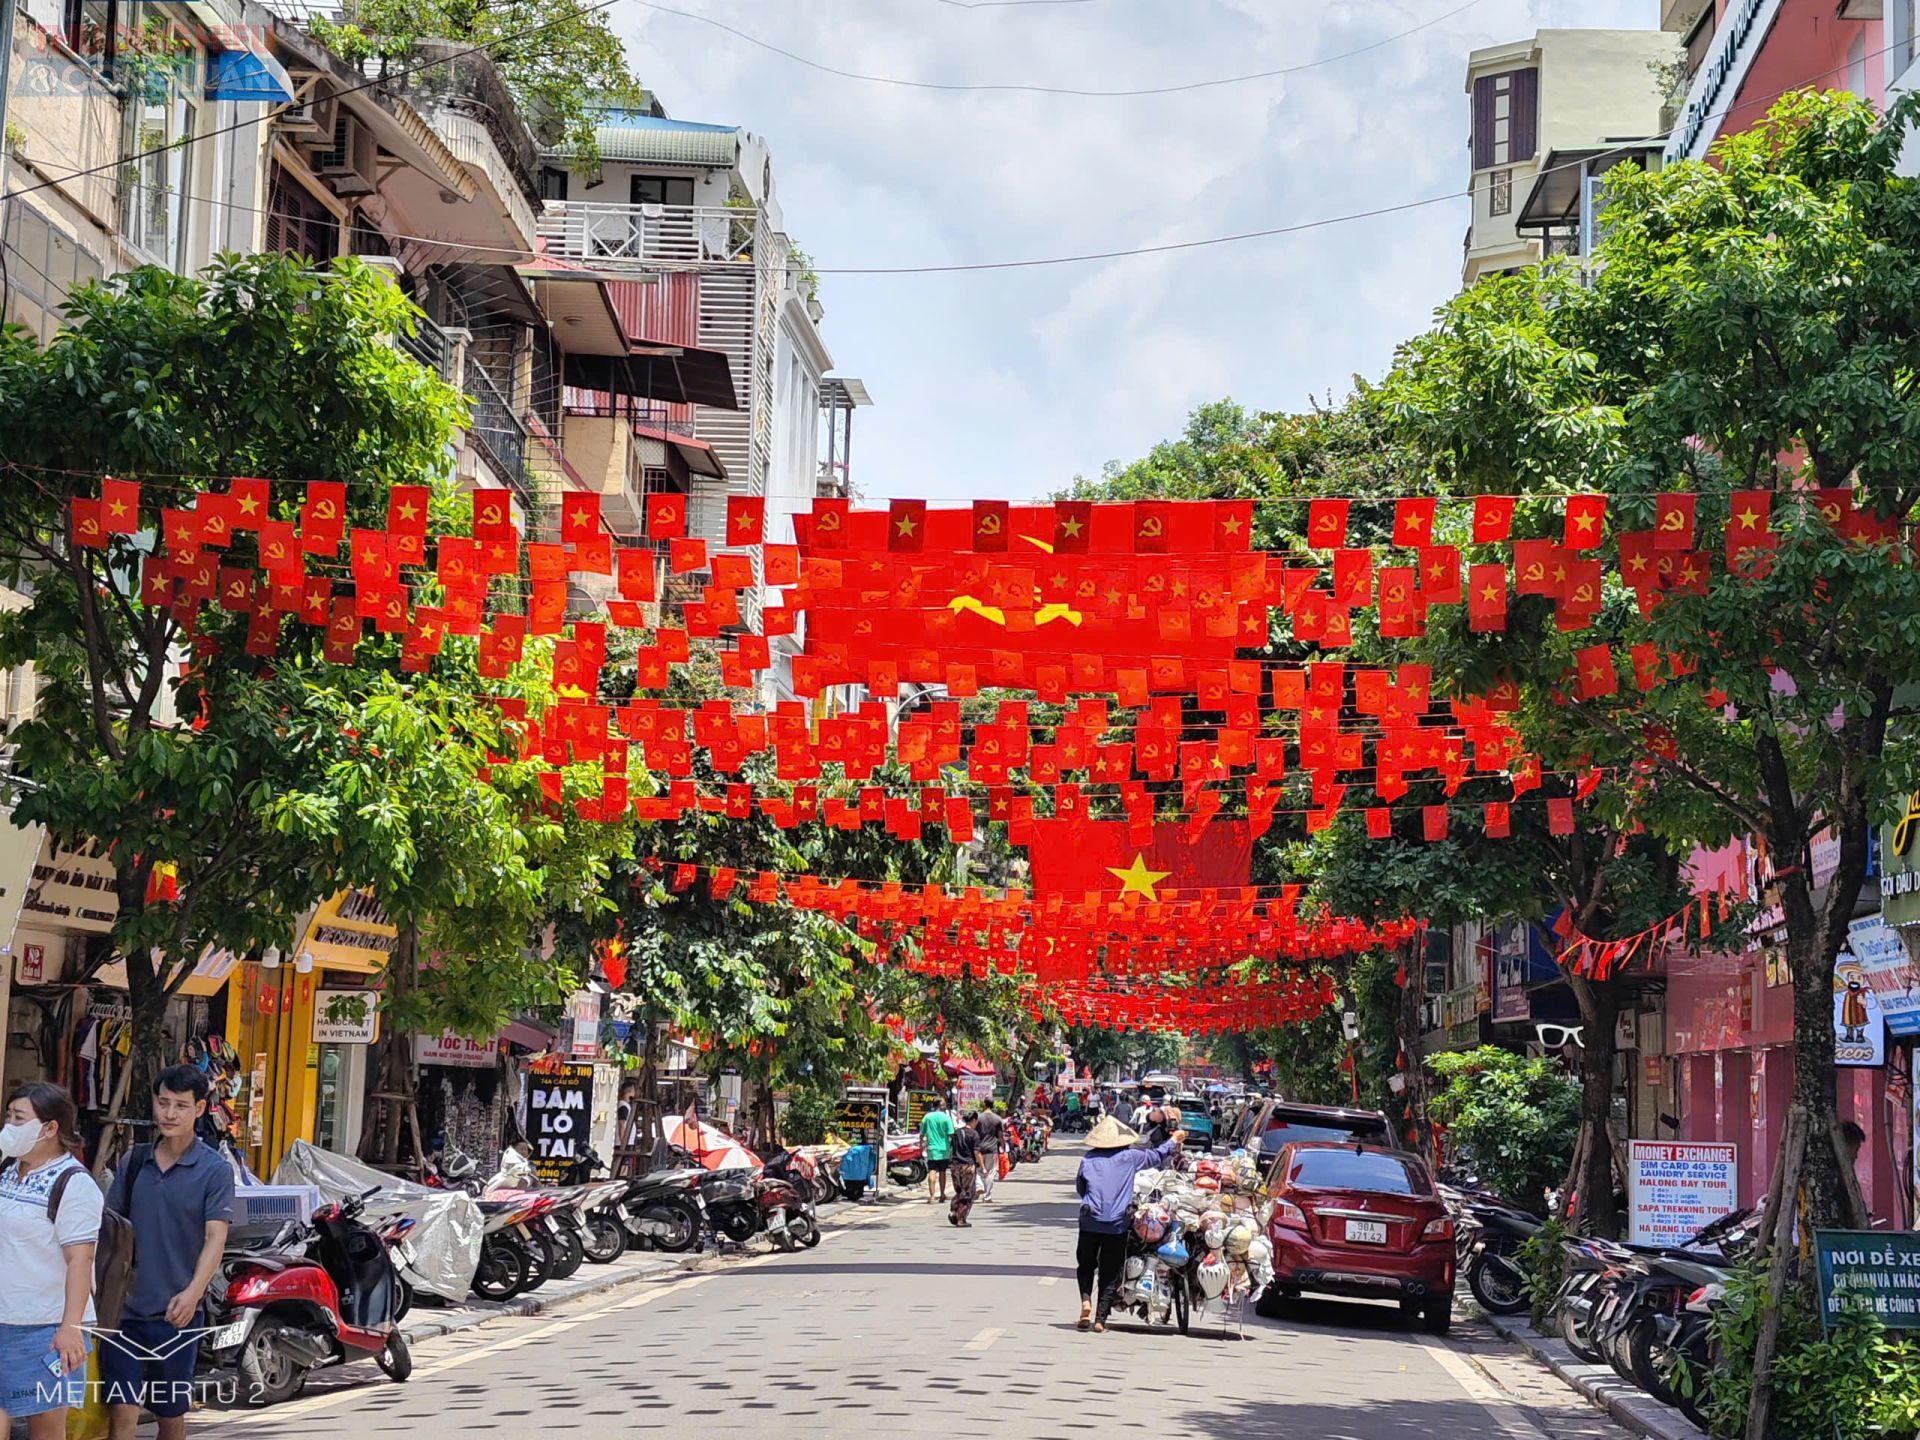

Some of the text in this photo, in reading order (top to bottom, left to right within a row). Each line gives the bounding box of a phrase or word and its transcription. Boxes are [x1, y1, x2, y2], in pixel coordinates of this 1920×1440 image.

[1834, 1045, 1873, 1061] acos
[838, 1121, 875, 1129] MASSAGE
[538, 1138, 575, 1157] TAI
[1634, 1145, 1733, 1162] MONEY EXCHANGE
[1640, 1161, 1658, 1169] SIM
[1661, 1162, 1689, 1170] CARD
[1692, 1163, 1706, 1171] 4G
[1713, 1163, 1727, 1171] 5G
[1640, 1170, 1727, 1179] LAUNDRY SERVICE
[1640, 1179, 1727, 1188] HALONG BAY TOUR
[1637, 1204, 1729, 1214] SAPA TREKKING TOUR
[1653, 1225, 1679, 1233] GIANG
[1351, 1231, 1382, 1241] 371.42
[1831, 1250, 1865, 1265] NƠI
[1870, 1243, 1896, 1266] ĐỂ
[1889, 1294, 1915, 1313] CÔNG
